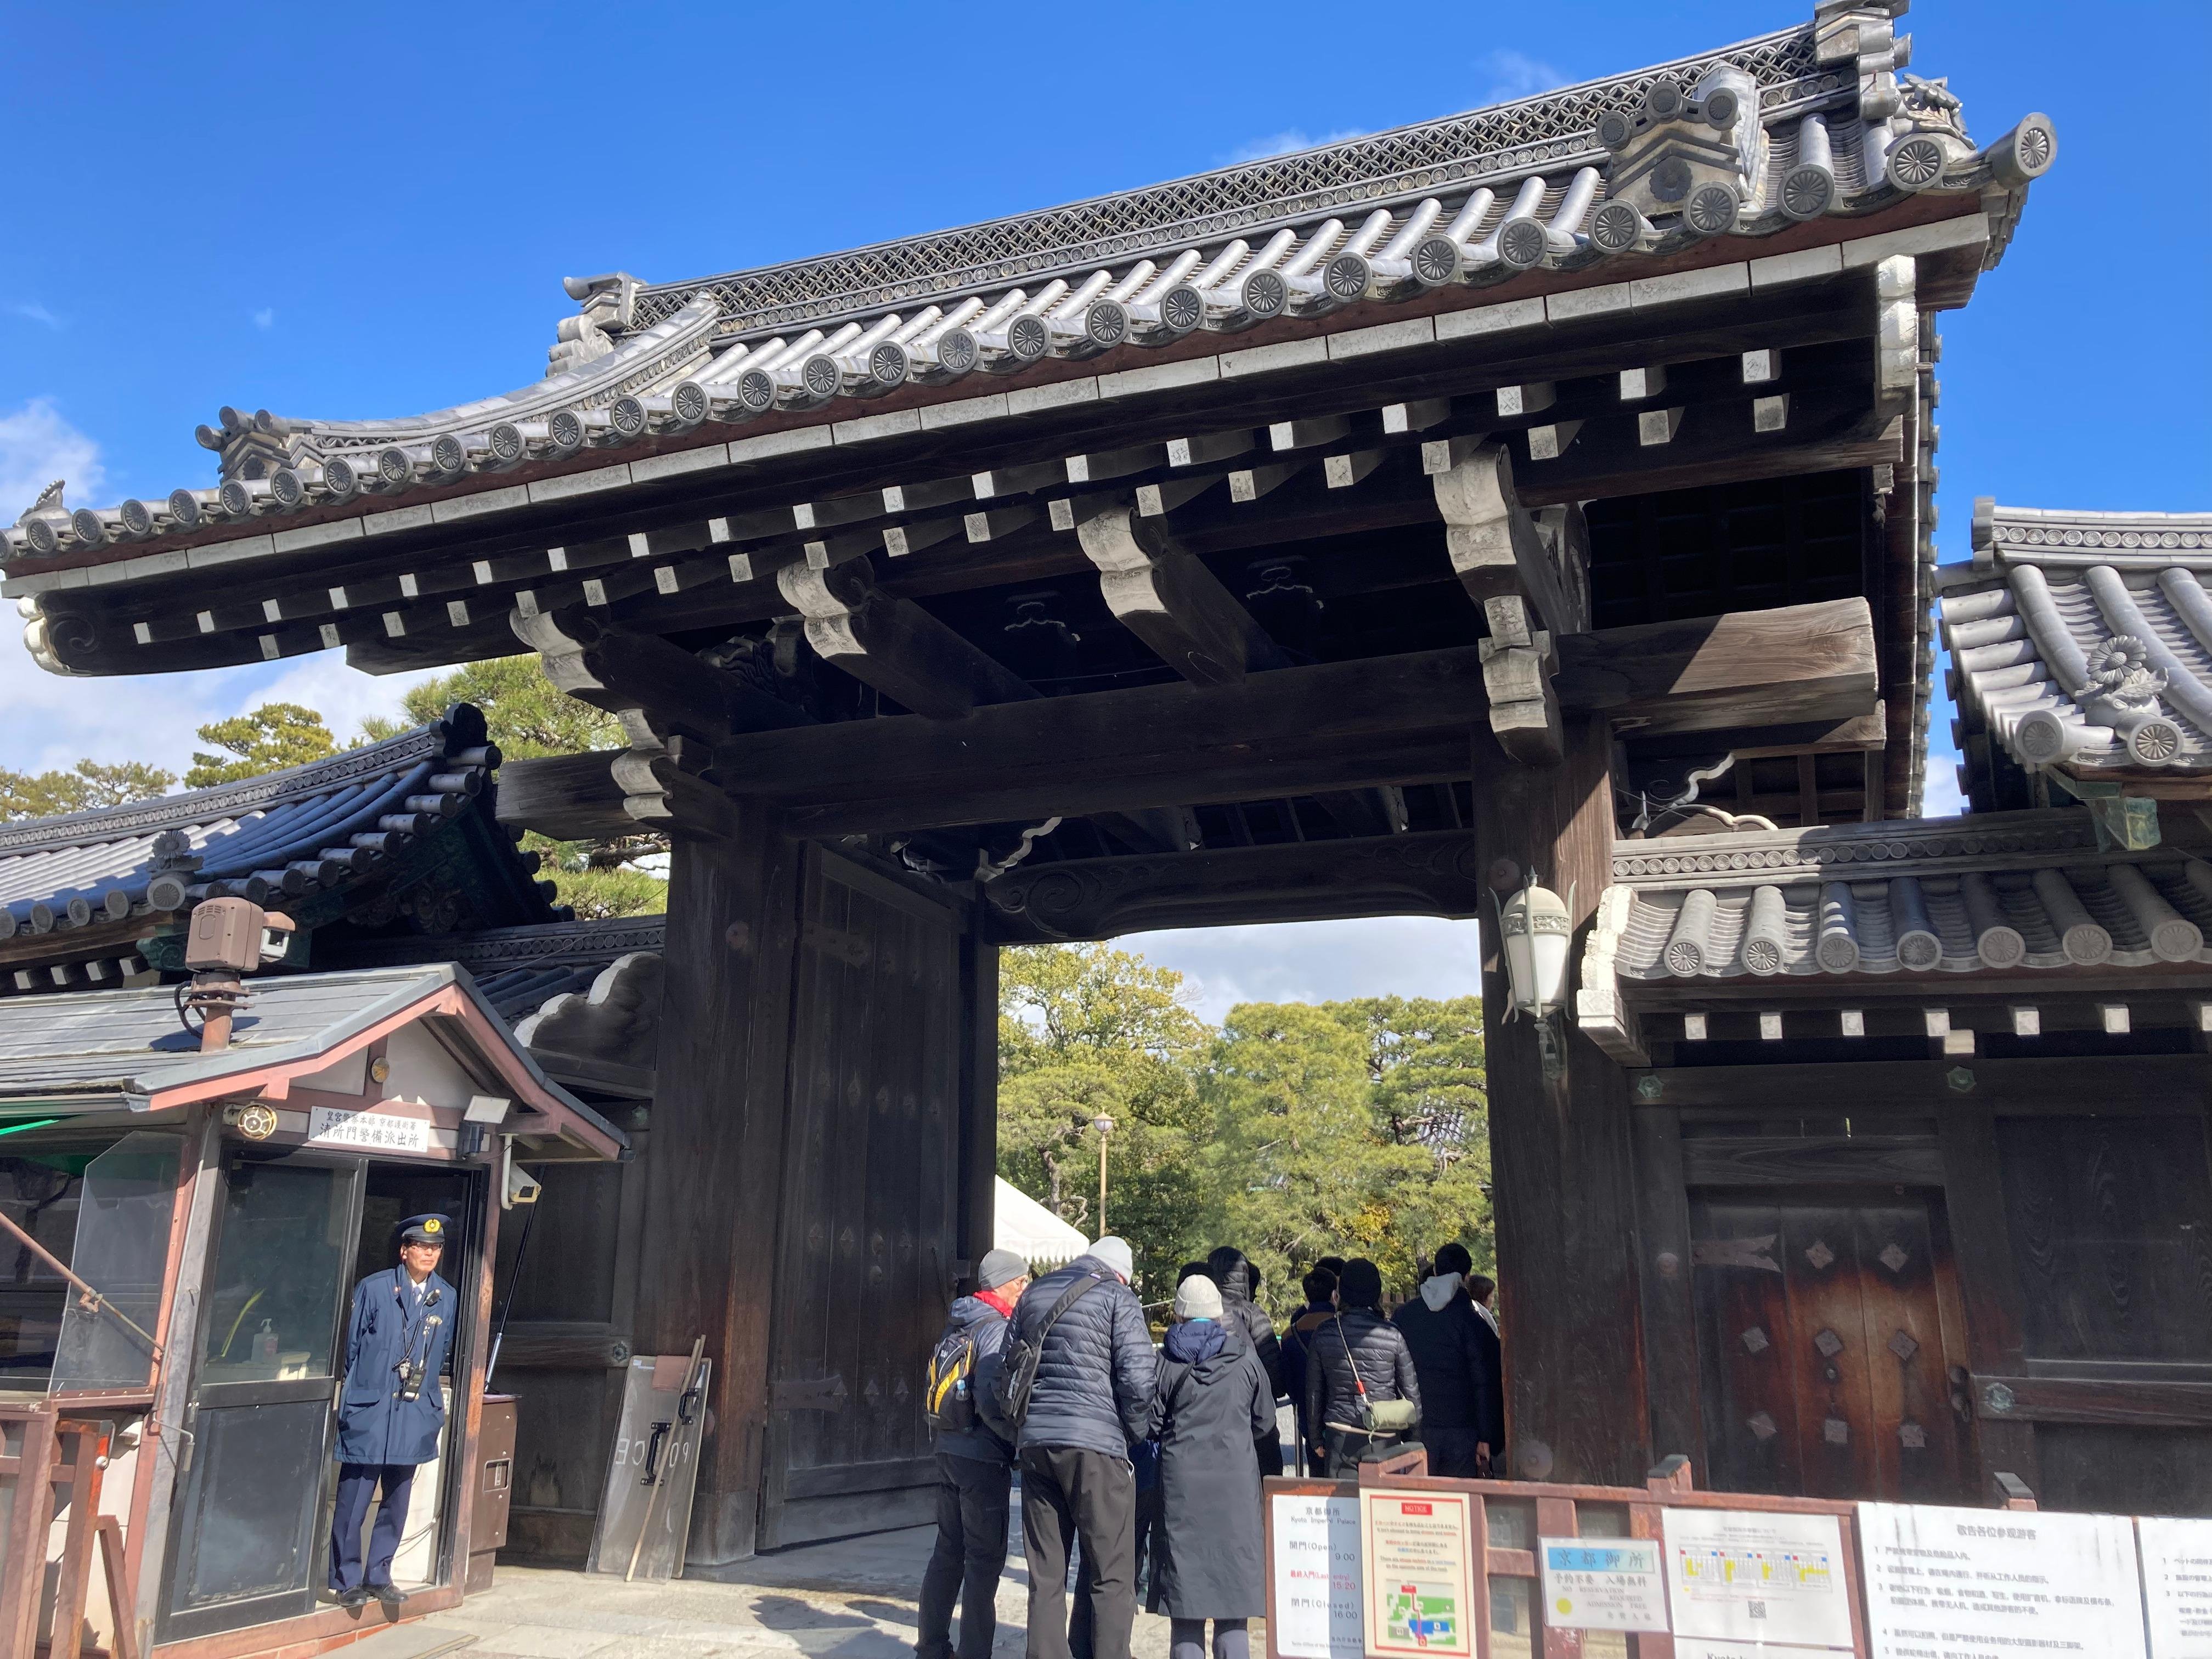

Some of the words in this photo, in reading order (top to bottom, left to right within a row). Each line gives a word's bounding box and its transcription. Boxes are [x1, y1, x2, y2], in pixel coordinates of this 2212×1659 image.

[326, 1110, 375, 1126] 皇宮警察本部
[320, 1123, 419, 1148] 清所門警備派出所
[1306, 1507, 1340, 1516] 京都御所
[1404, 1505, 1427, 1513] NOTICE
[1558, 1550, 1644, 1568] 京都御所
[1877, 1564, 1881, 1572] 2
[1555, 1572, 1594, 1585] 予約不要
